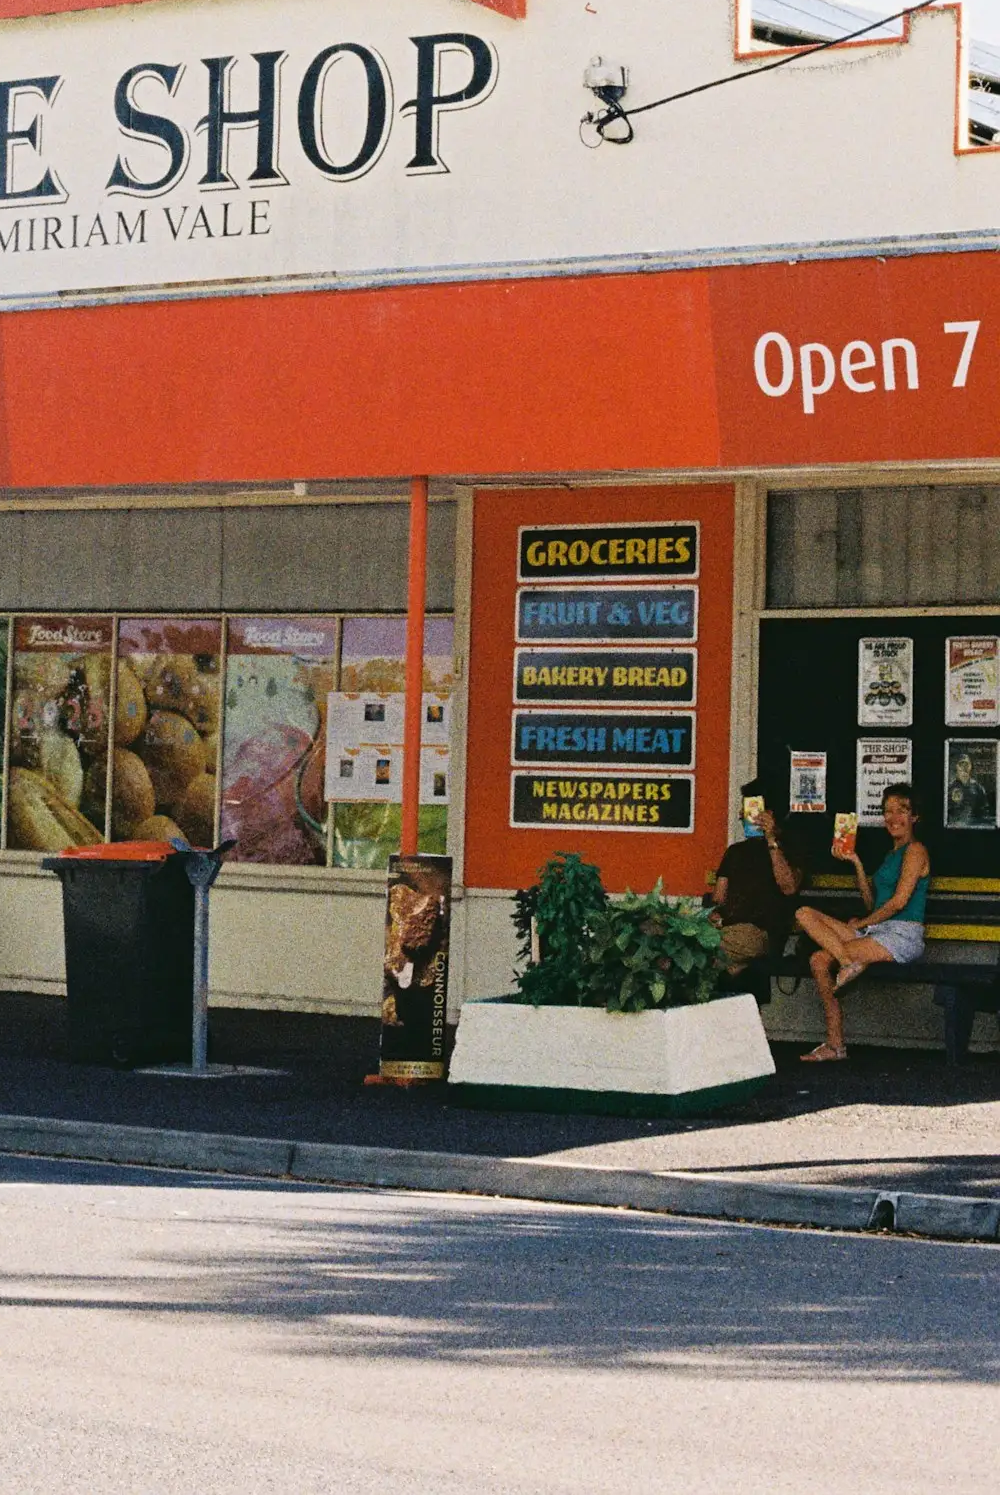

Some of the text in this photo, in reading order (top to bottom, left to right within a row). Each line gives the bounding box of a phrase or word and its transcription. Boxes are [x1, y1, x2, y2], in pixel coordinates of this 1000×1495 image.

[105, 32, 500, 199] SHOP
[162, 200, 272, 242] VALE
[754, 320, 981, 414] Open 7
[526, 537, 691, 566] GROCERIES
[523, 601, 689, 626] FRUIT & VEG
[28, 625, 102, 644] Food Store
[522, 666, 687, 687] BAKERY BREAD
[520, 726, 687, 753] FRESH MEAT
[862, 745, 908, 753] THE SHOP
[533, 781, 671, 801] NEWSPAPERS
[542, 803, 660, 823] MAGAZINES
[431, 951, 447, 1057] CONNOISSEUR
